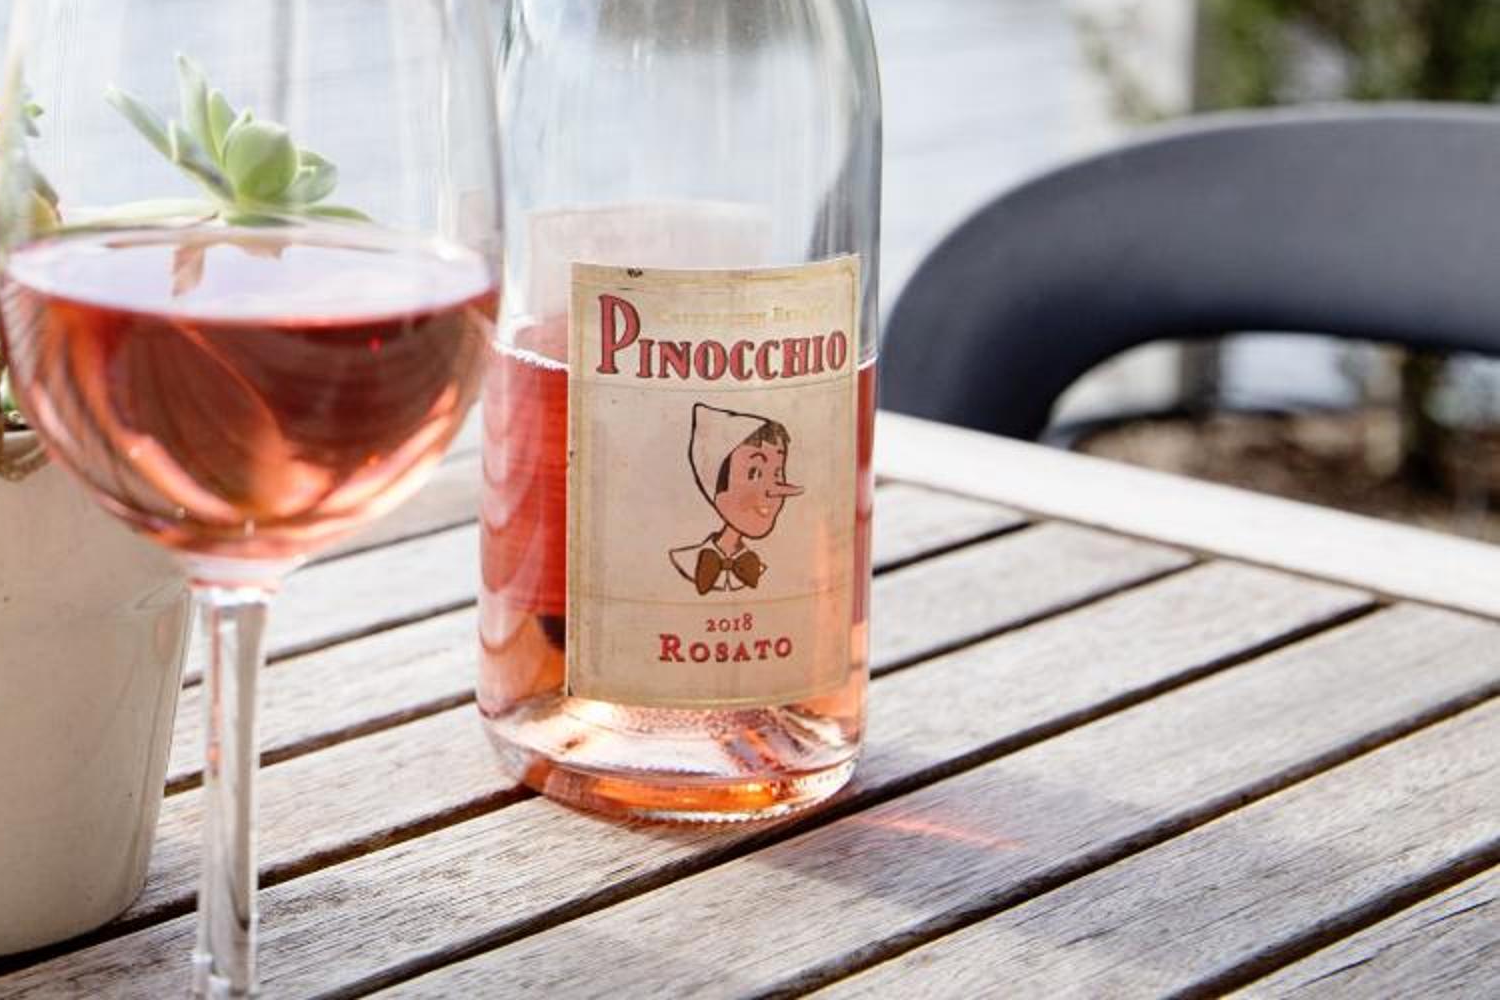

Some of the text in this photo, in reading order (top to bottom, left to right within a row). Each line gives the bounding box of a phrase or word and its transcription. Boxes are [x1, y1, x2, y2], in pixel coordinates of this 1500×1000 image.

[596, 293, 847, 381] PINOCCHIO
[705, 612, 753, 633] 2018
[658, 633, 793, 663] ROSATO
